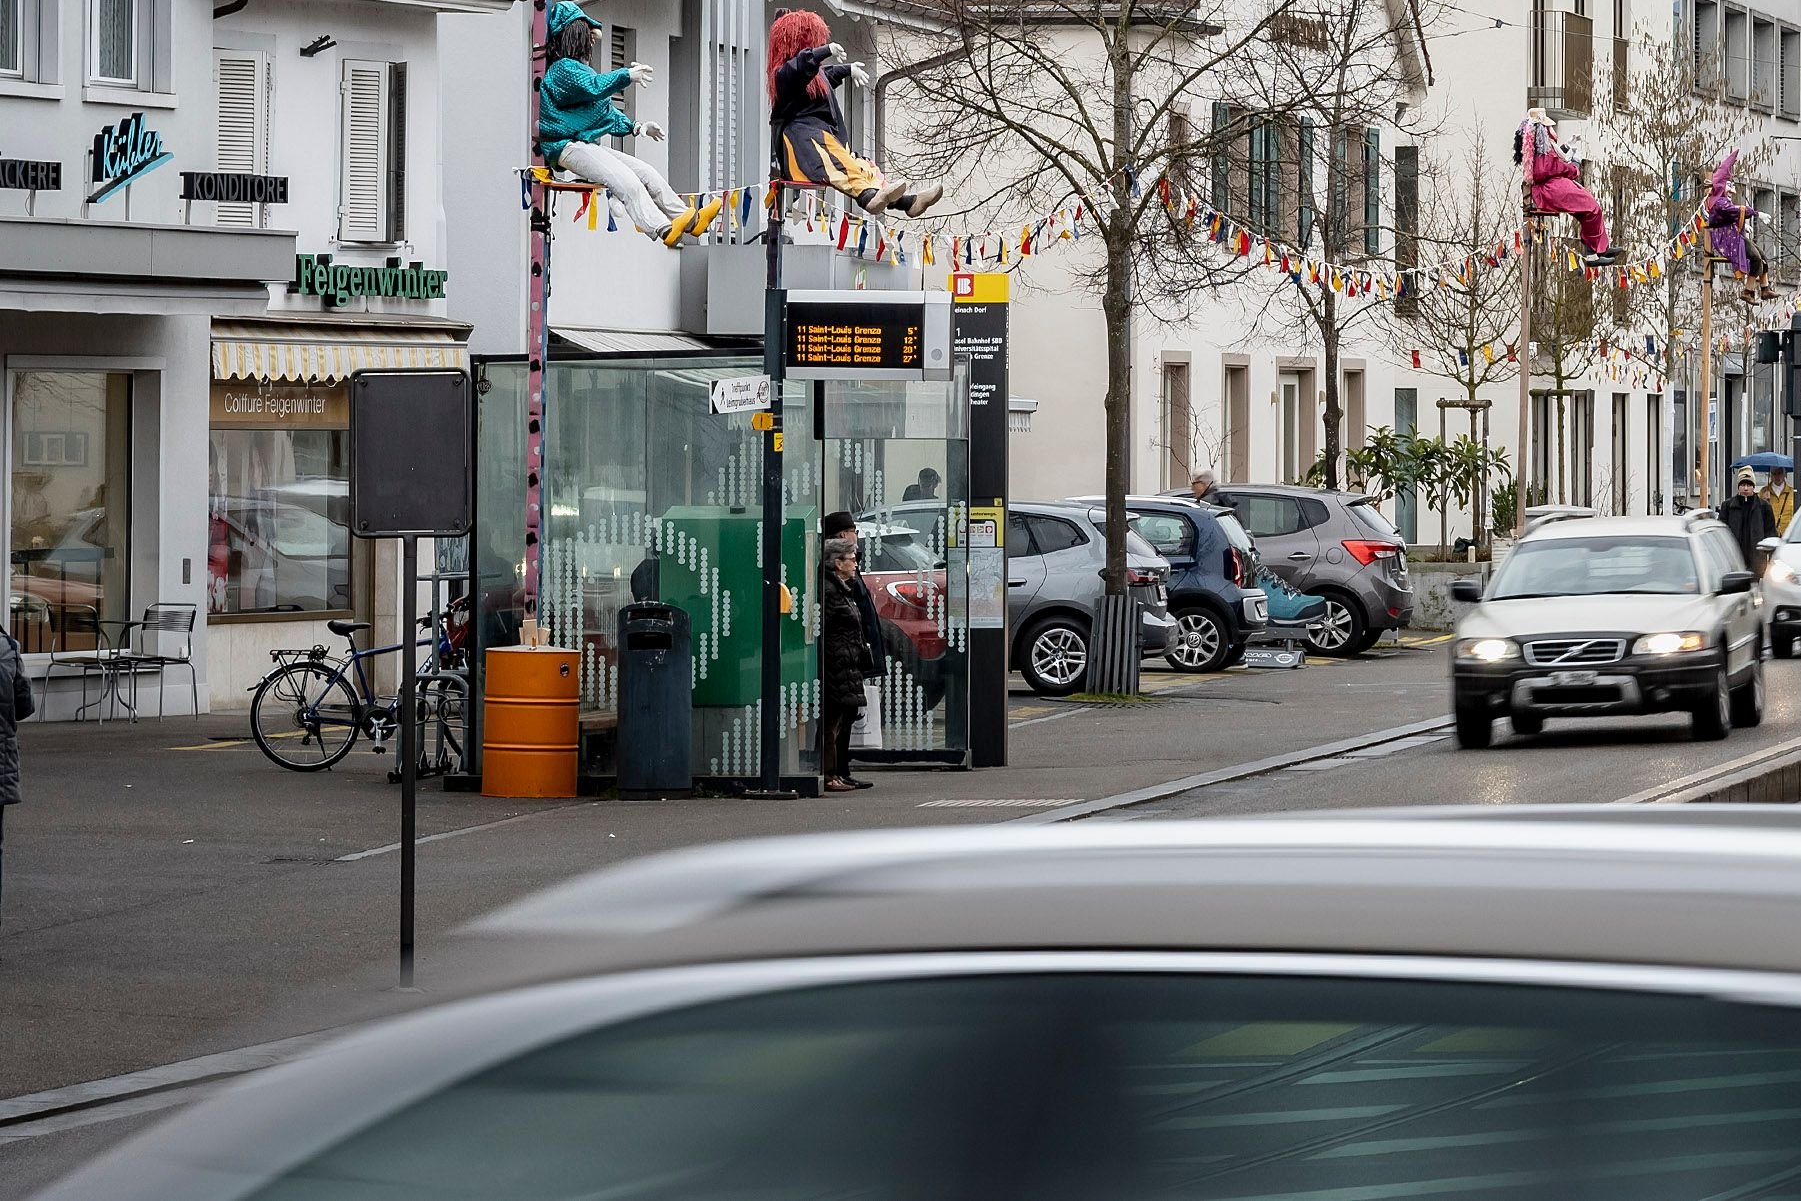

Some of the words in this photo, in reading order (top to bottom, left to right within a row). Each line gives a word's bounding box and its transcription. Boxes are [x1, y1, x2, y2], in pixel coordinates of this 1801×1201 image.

[102, 112, 163, 180] Kübler
[298, 254, 448, 307] Feigenwinter
[797, 326, 806, 334] 11
[808, 326, 852, 334] Saint-Louis
[854, 326, 882, 334] Grenze
[797, 335, 806, 344] 11
[808, 335, 852, 344] Saint-Louis
[854, 335, 882, 344] Grenze
[967, 337, 991, 345] Bahnhof
[797, 344, 806, 353] 11
[808, 344, 852, 353] Saint-Louis
[854, 344, 882, 353] Grenze
[954, 345, 999, 353] niversitätsspital
[797, 354, 806, 362] 11
[808, 354, 852, 362] Saint-Louis
[854, 354, 882, 362] Grenze
[224, 392, 262, 413] Coiffure
[264, 394, 326, 418] Feigenwinter
